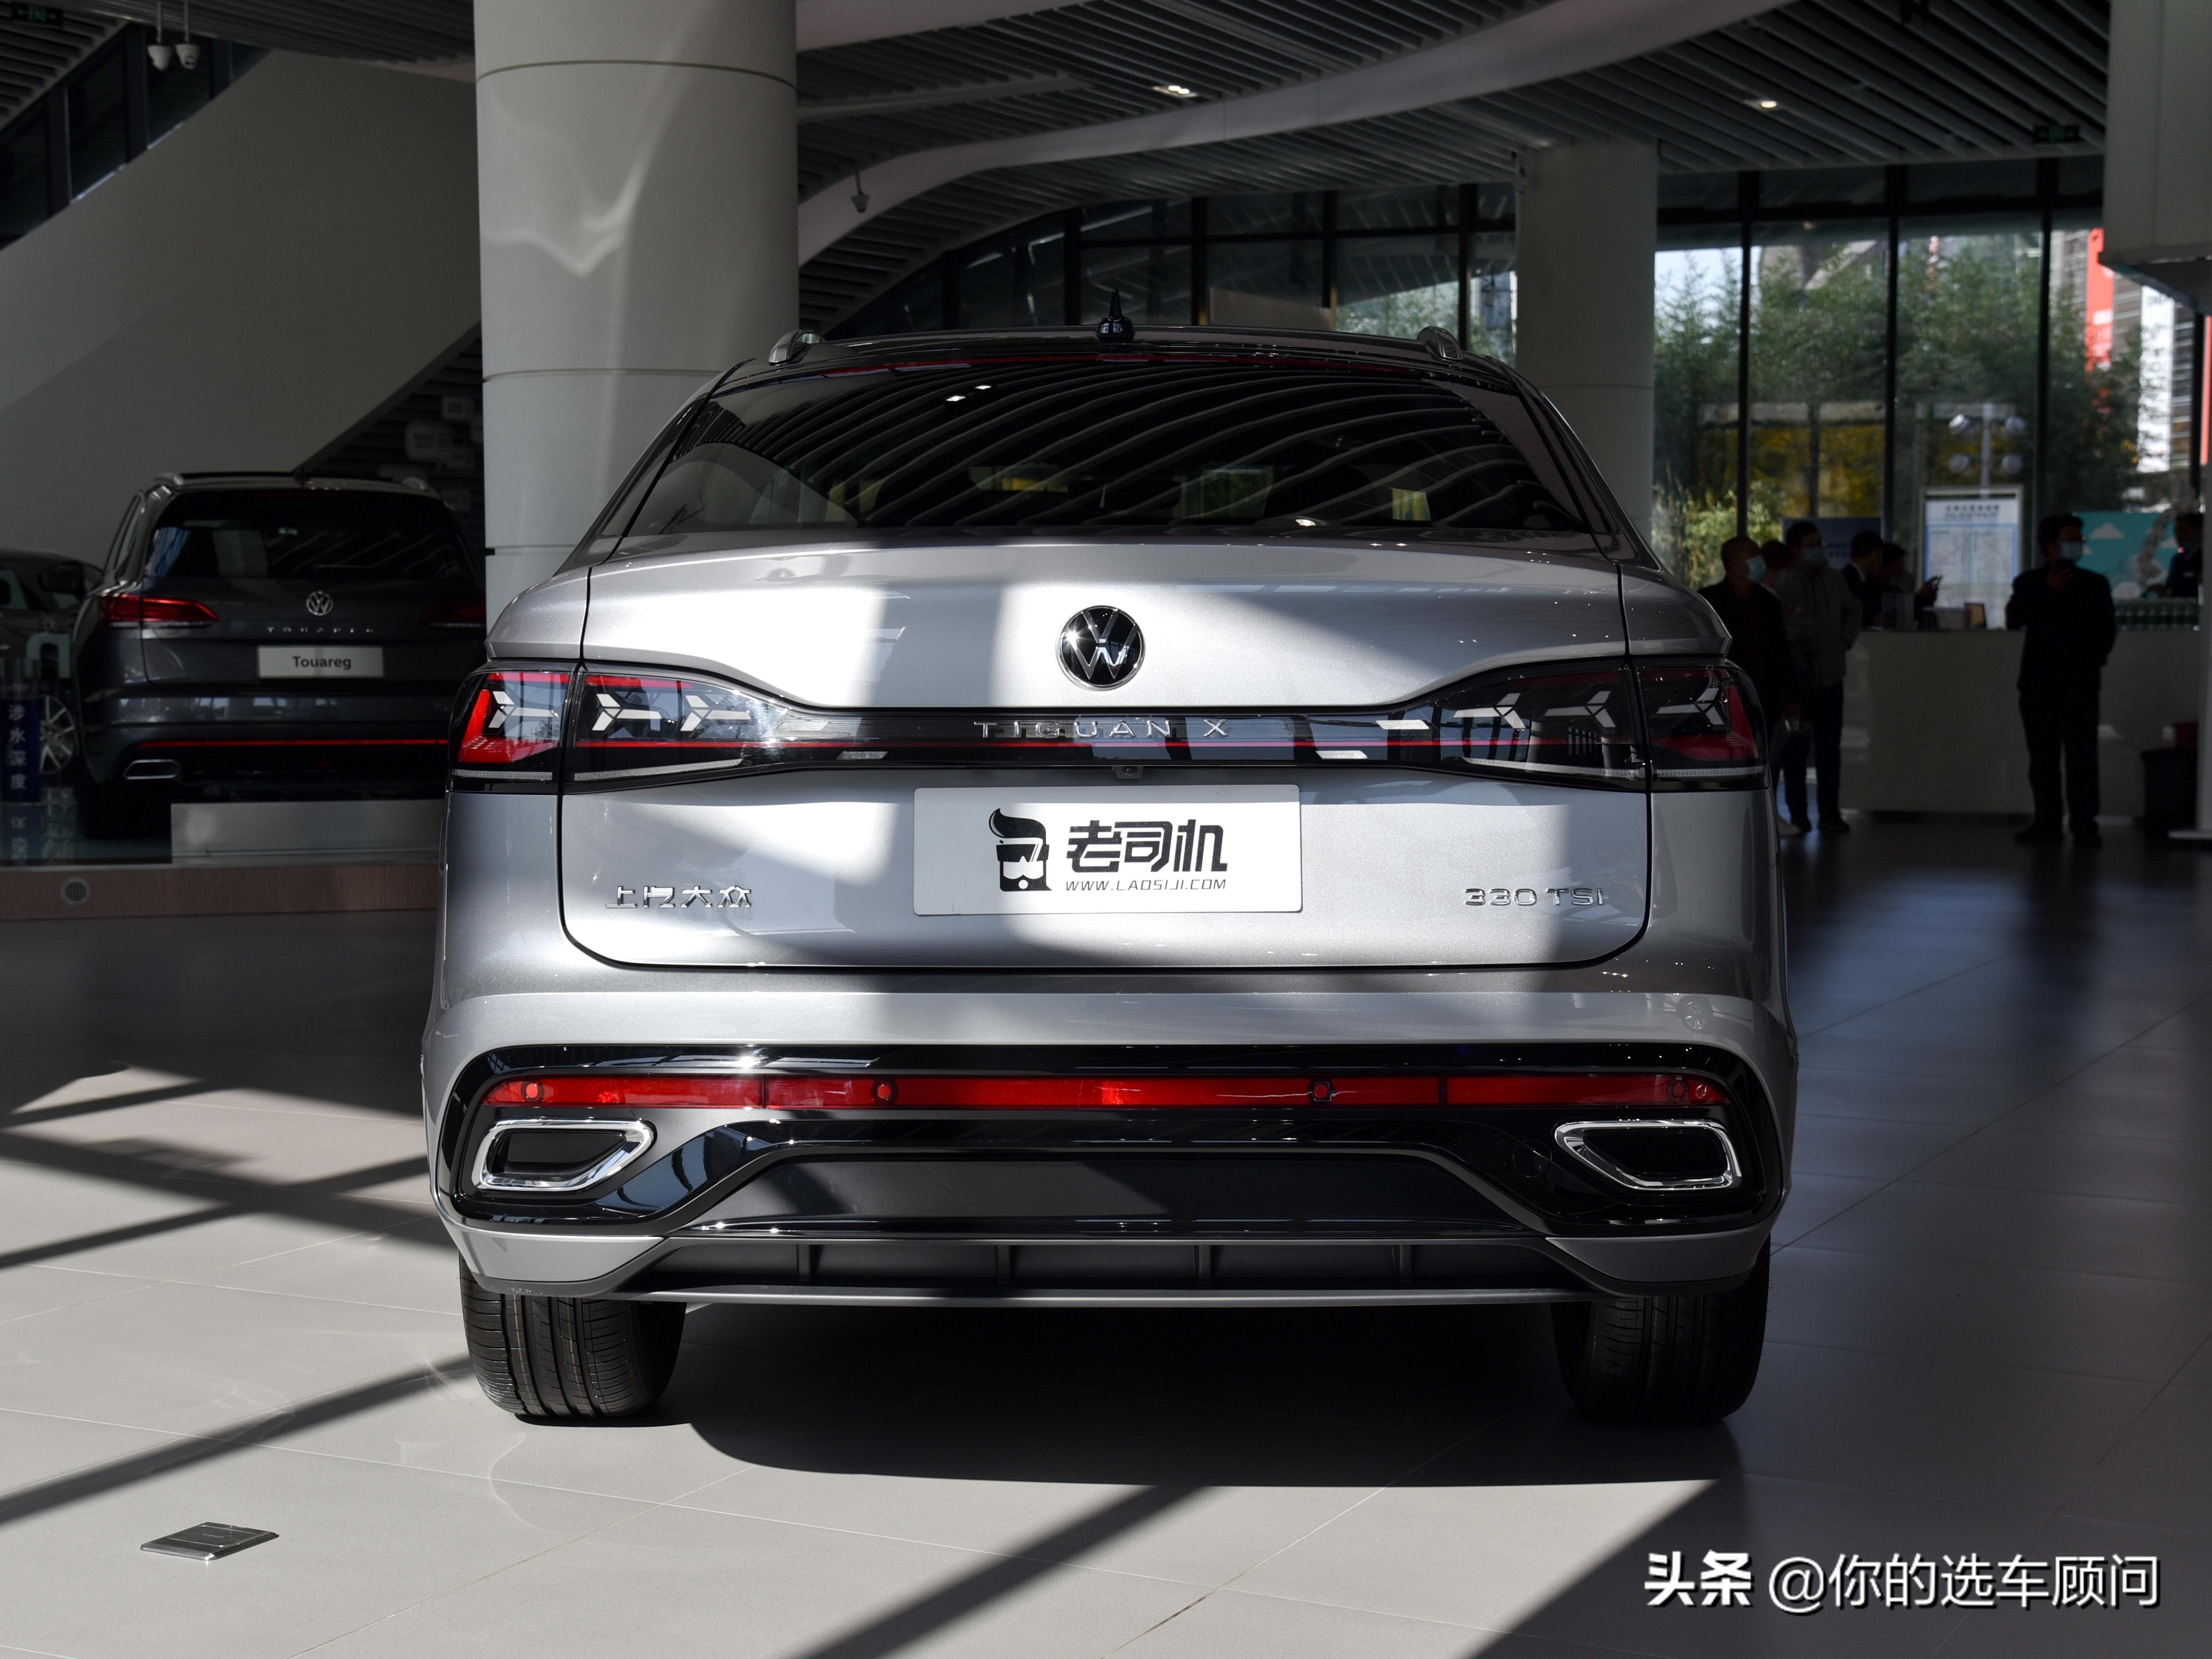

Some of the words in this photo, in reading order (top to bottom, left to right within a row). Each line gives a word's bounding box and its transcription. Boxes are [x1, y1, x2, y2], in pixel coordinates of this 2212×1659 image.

[293, 656, 351, 671] Touareg
[973, 719, 1171, 739] TIGUAN
[1203, 718, 1229, 738] X
[1066, 819, 1228, 873] 老司机
[1066, 879, 1227, 891] WWW.LAOSIJI.COM
[604, 885, 752, 909] 上汽大众
[1463, 888, 1537, 906] 330
[1545, 888, 1604, 906] TSI
